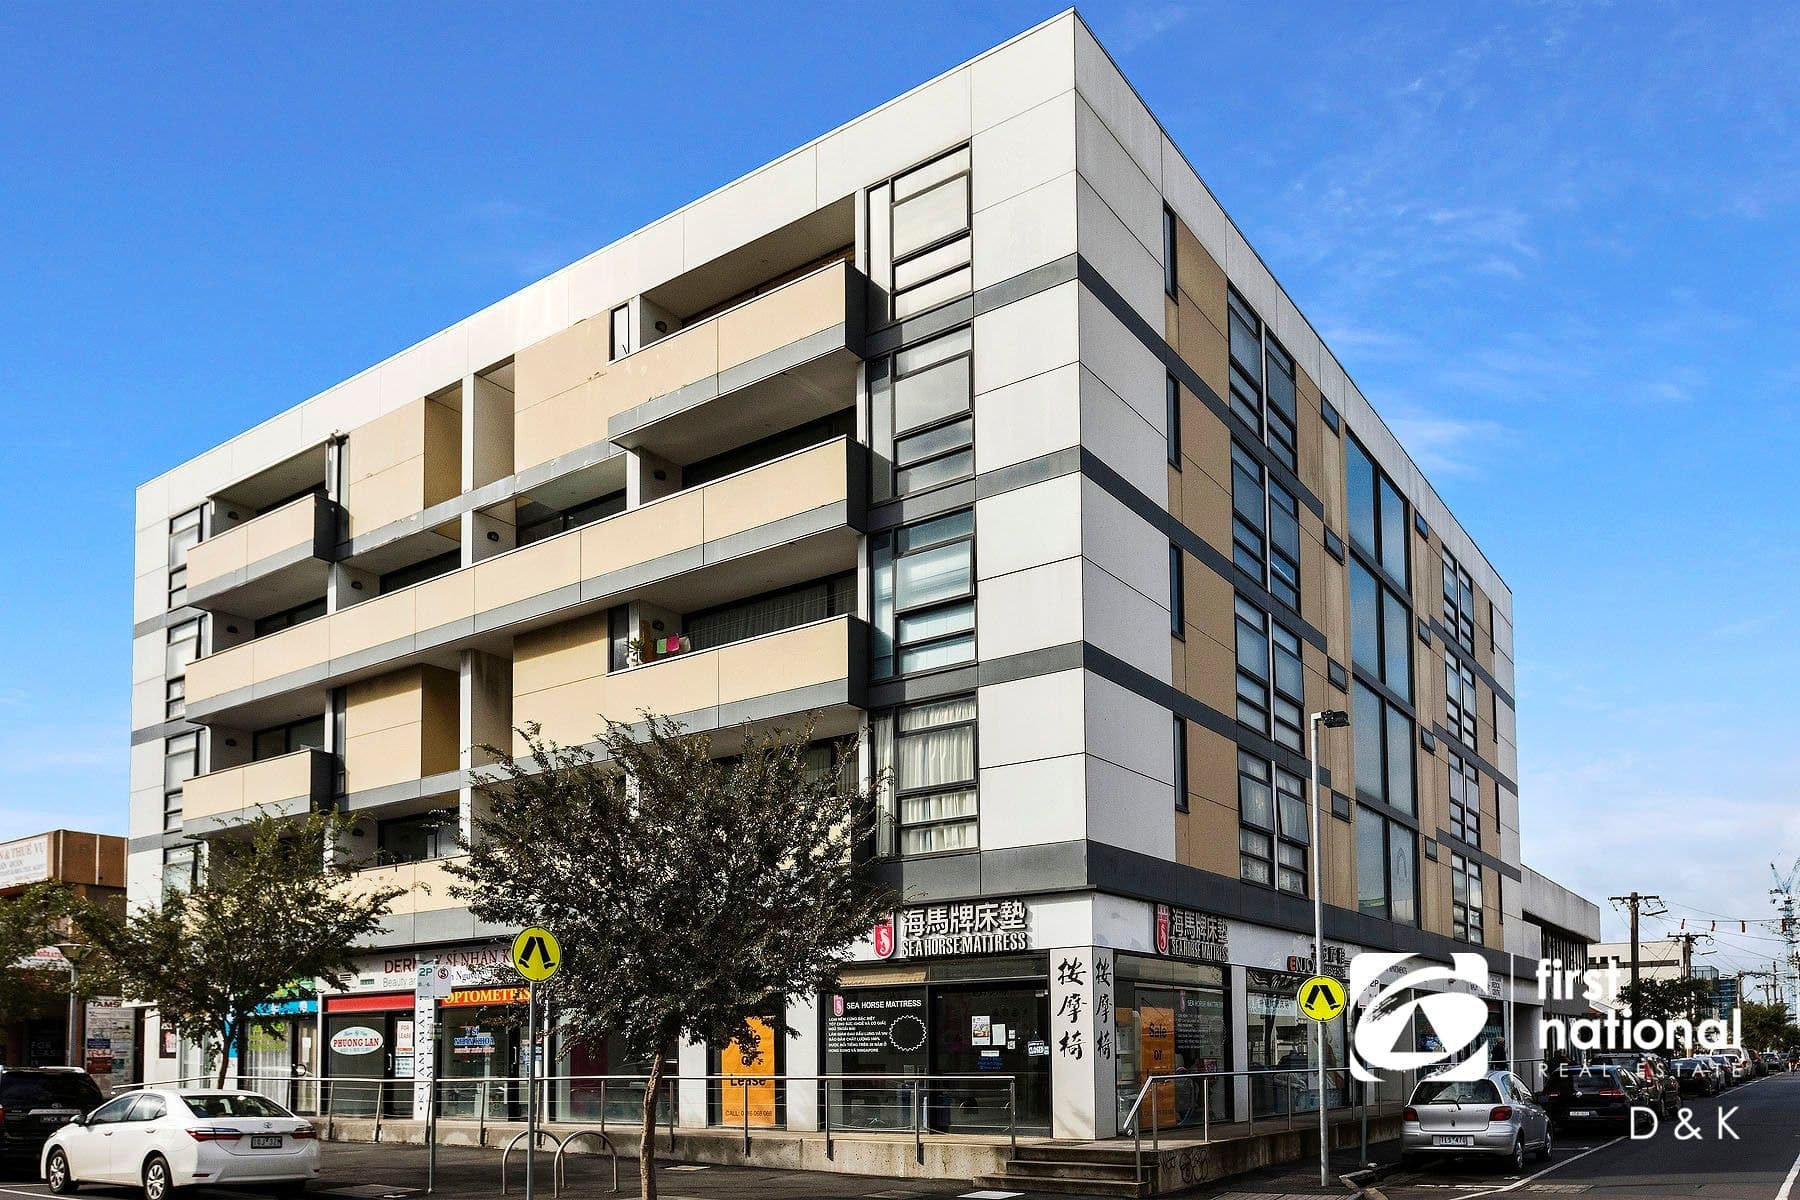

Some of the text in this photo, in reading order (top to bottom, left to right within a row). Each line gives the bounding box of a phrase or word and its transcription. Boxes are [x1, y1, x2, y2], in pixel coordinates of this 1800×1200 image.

[901, 901, 1026, 937] 海馬牌床墊
[902, 932, 1027, 957] SEA HORSE MATTRESS
[419, 968, 433, 976] 2P
[846, 999, 922, 1010] SEA HORSE MATTRESS
[1149, 1023, 1168, 1038] Sale
[365, 1038, 380, 1047] LAN
